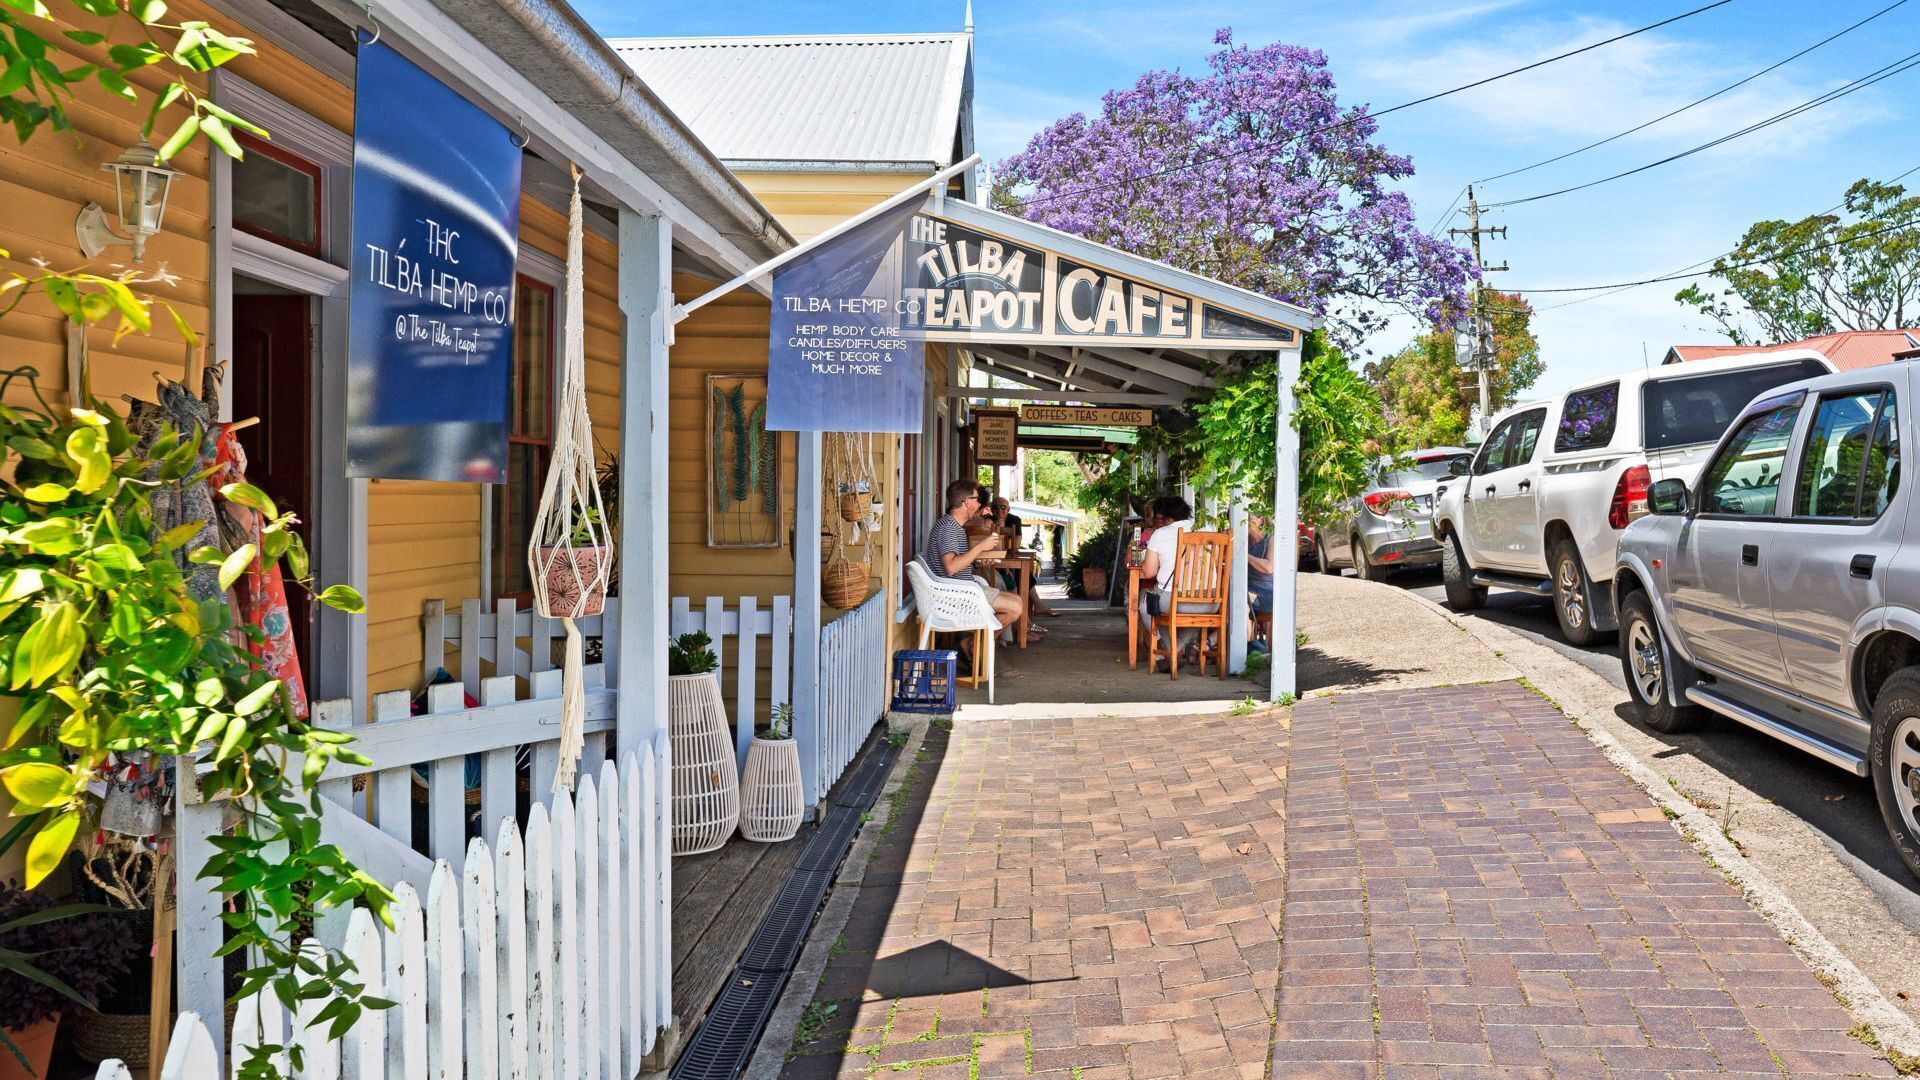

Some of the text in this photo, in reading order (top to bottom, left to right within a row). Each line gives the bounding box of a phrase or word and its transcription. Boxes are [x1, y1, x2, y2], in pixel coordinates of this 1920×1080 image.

[425, 218, 460, 264] THC
[909, 215, 947, 245] THE
[916, 239, 1027, 288] TILBA
[366, 243, 508, 327] TILBA HEMP CO.
[783, 296, 831, 313] TILBA
[839, 298, 887, 315] HEMP
[905, 287, 1041, 330] TEAPOT
[1057, 267, 1188, 337] CAFE
[395, 313, 481, 366] @ The Tilba Teapot
[788, 338, 907, 350] CANDLES/DIFFUSERS
[796, 325, 899, 337] HEMP BODY CARE
[801, 351, 892, 362] HOME DECOR &
[811, 363, 882, 375] MUCH MORE
[1025, 408, 1142, 423] COFFEES TEAS CAKES
